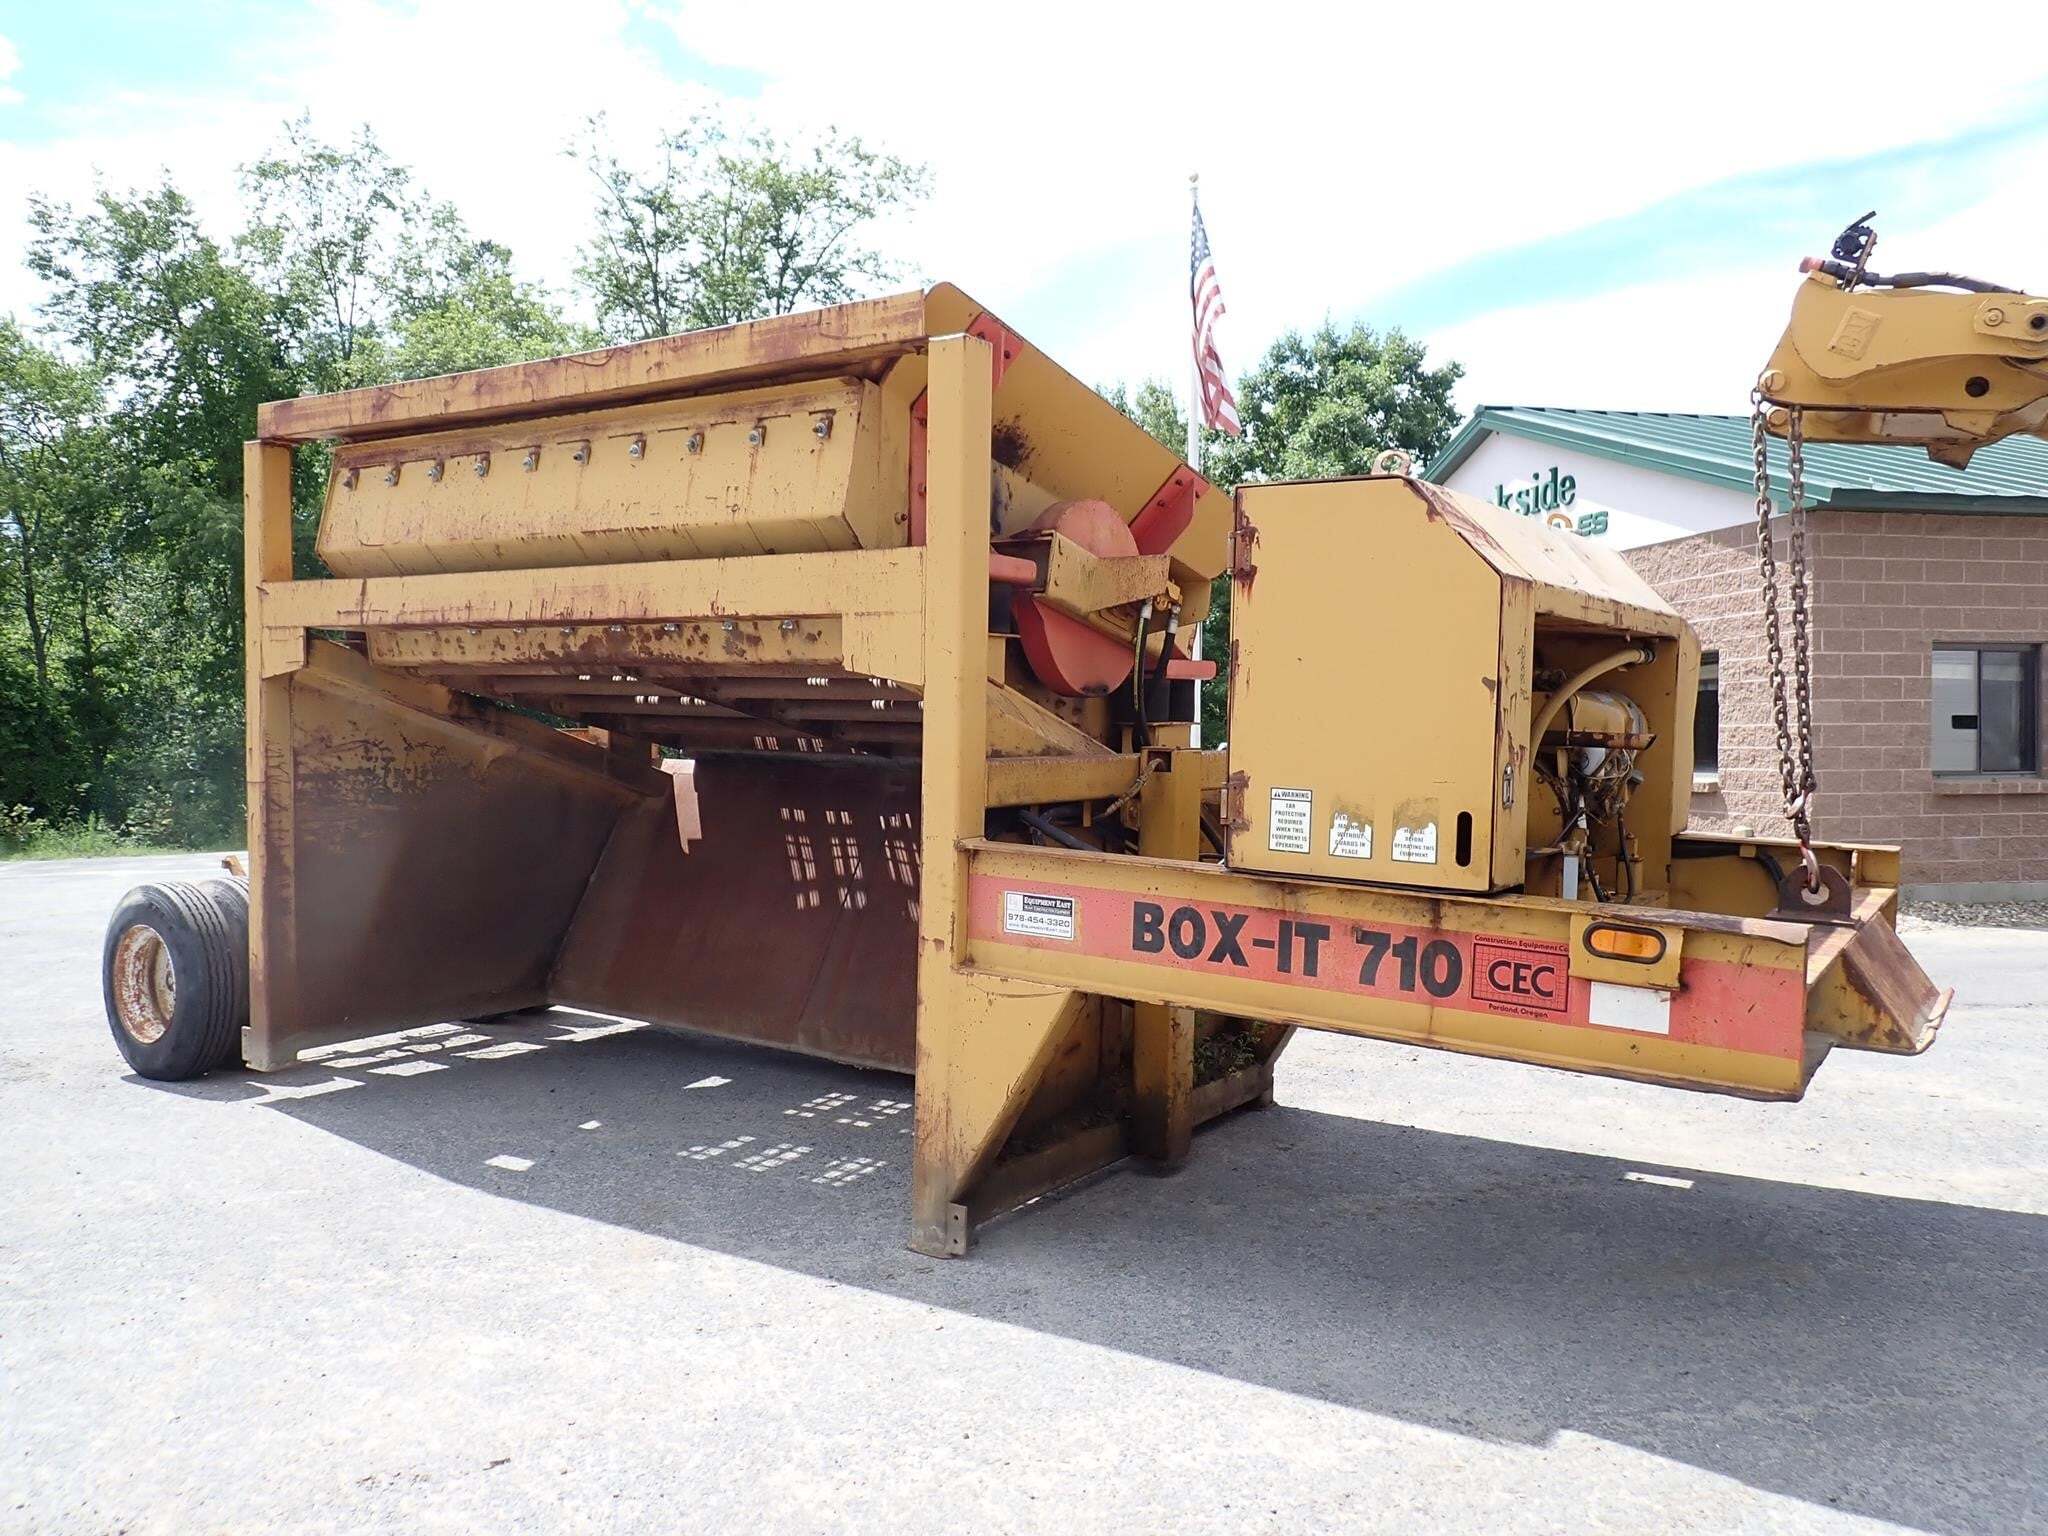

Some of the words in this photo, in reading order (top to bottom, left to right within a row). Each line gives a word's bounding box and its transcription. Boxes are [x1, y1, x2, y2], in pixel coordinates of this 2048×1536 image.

[1281, 791, 1309, 799] WARNING
[1132, 901, 1331, 977] BOX-IT
[1355, 929, 1463, 998] 710
[1474, 934, 1517, 946] Construction
[1519, 940, 1557, 951] Equipment
[1488, 960, 1554, 997] CEC
[1520, 1008, 1548, 1018] Oregon
